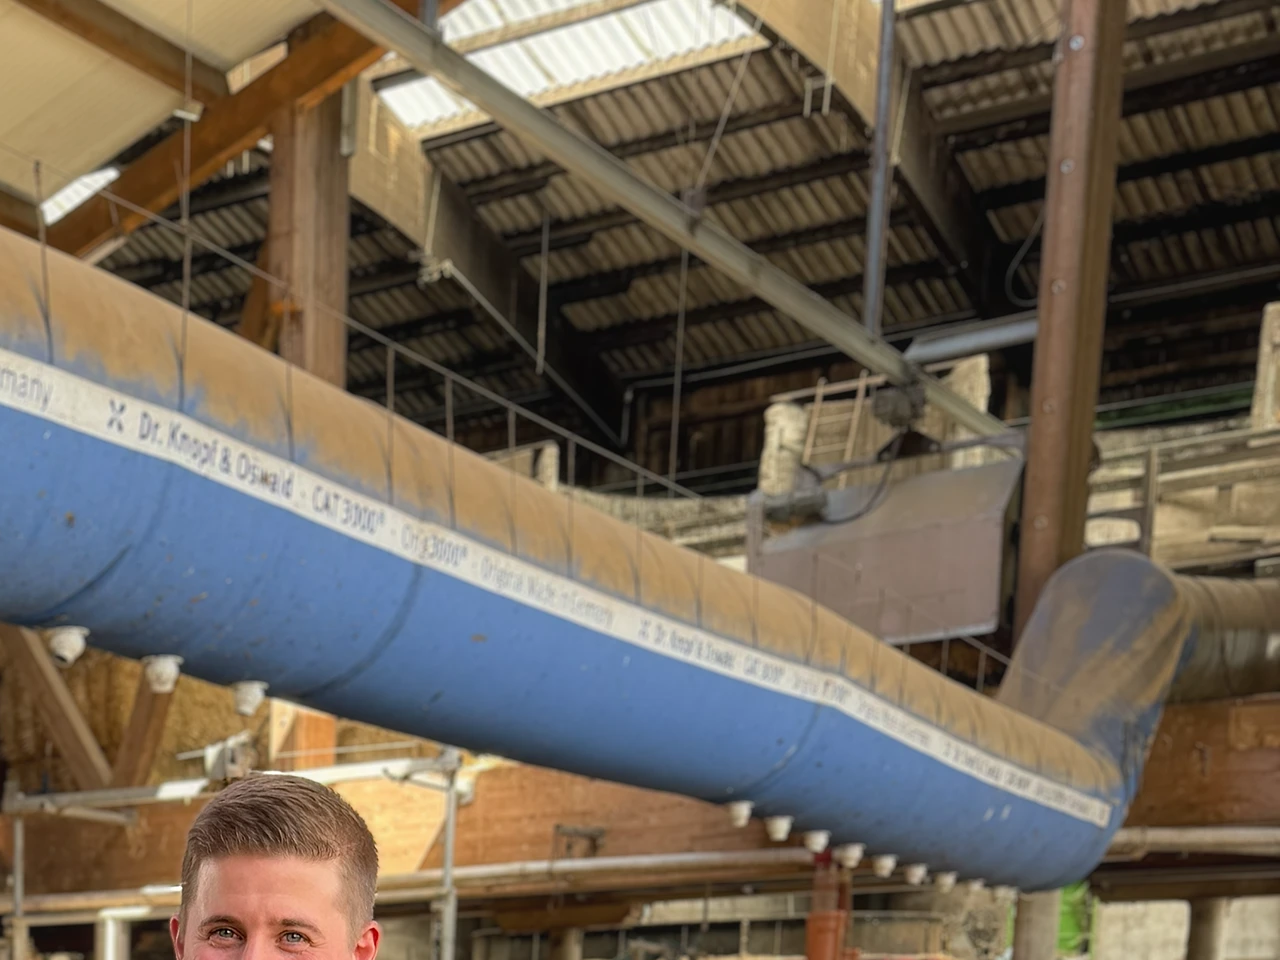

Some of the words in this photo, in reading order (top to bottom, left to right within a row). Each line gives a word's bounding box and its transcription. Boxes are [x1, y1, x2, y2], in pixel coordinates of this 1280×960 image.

[138, 411, 163, 446] Dr.
[168, 421, 218, 468] Knopf
[220, 447, 232, 475] &
[235, 452, 296, 499] Oswald
[312, 485, 340, 519] CAT
